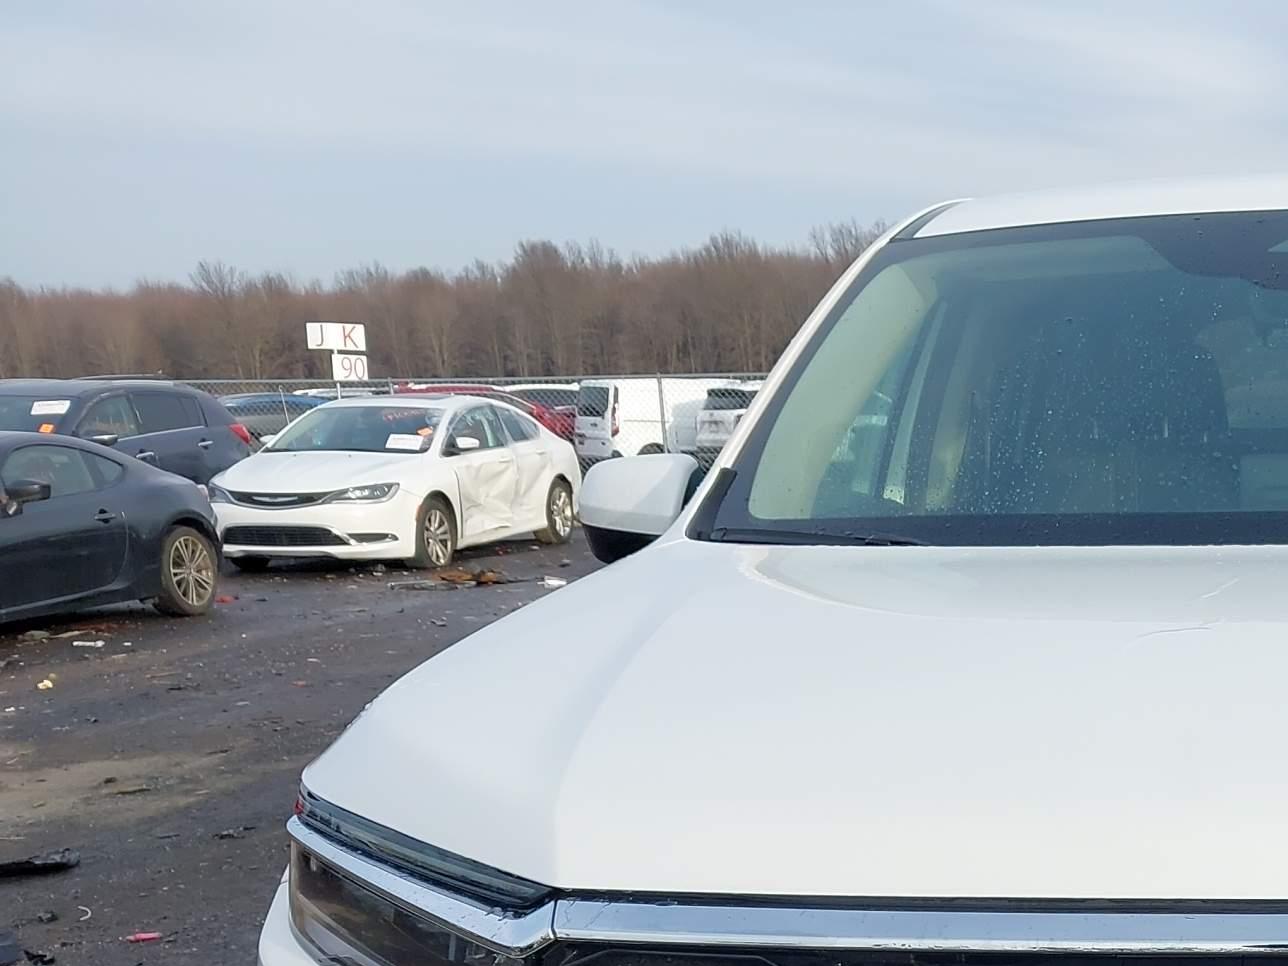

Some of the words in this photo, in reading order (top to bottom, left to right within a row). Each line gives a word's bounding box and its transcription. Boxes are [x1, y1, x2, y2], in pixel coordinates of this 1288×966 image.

[315, 323, 324, 347] J
[342, 325, 359, 349] K
[341, 356, 366, 380] 90
